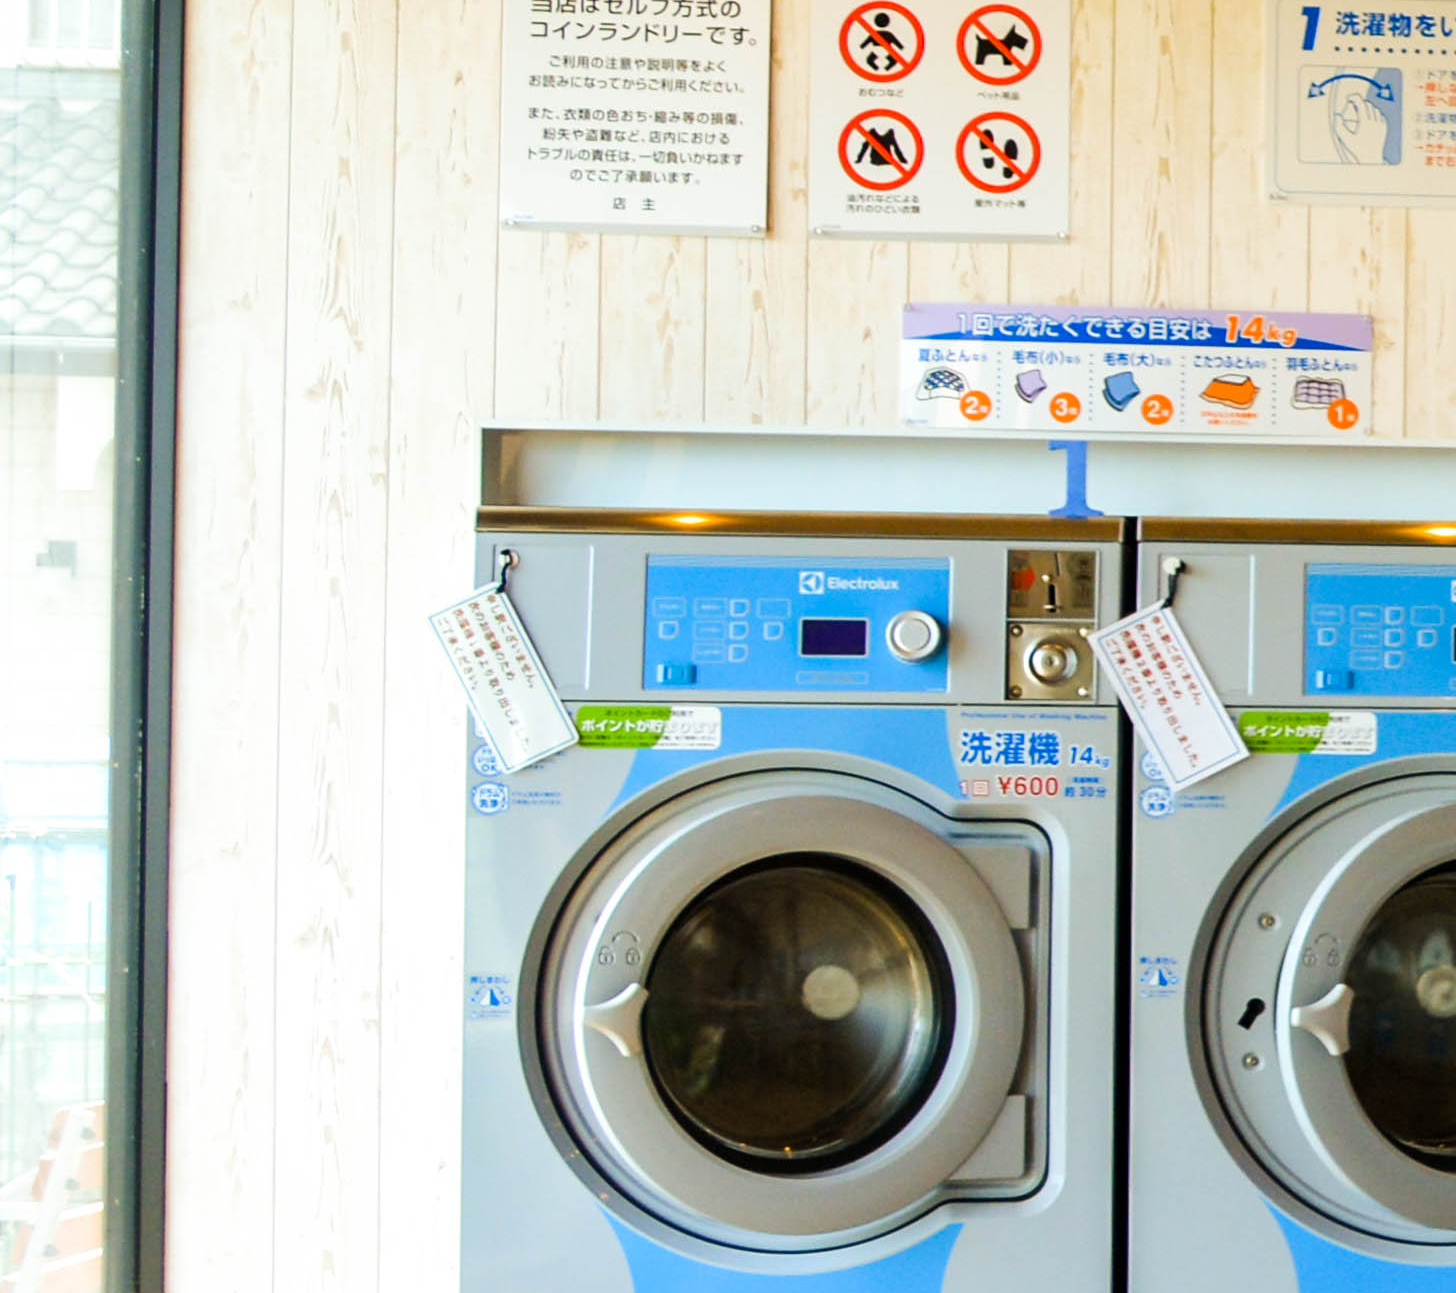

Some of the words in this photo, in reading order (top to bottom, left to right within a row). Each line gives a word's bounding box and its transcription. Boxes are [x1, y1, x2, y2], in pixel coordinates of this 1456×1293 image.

[530, 20, 758, 47] コインランドリーです。
[1300, 5, 1321, 52] 1
[548, 54, 727, 73] ご利用の注意や説明等をよく
[528, 73, 745, 94] お読みになってからご利用ください。
[527, 147, 744, 166] トラブルの責任は、一切負いかねます
[957, 313, 1212, 340] 1回で洗たくできる目安は
[1225, 315, 1297, 347] 14kg
[1047, 440, 1104, 518] 1
[828, 577, 899, 590] Electrolux
[960, 731, 1060, 765] 洗濯機
[1070, 746, 1110, 768] 14kg
[998, 776, 1060, 796] ¥600
